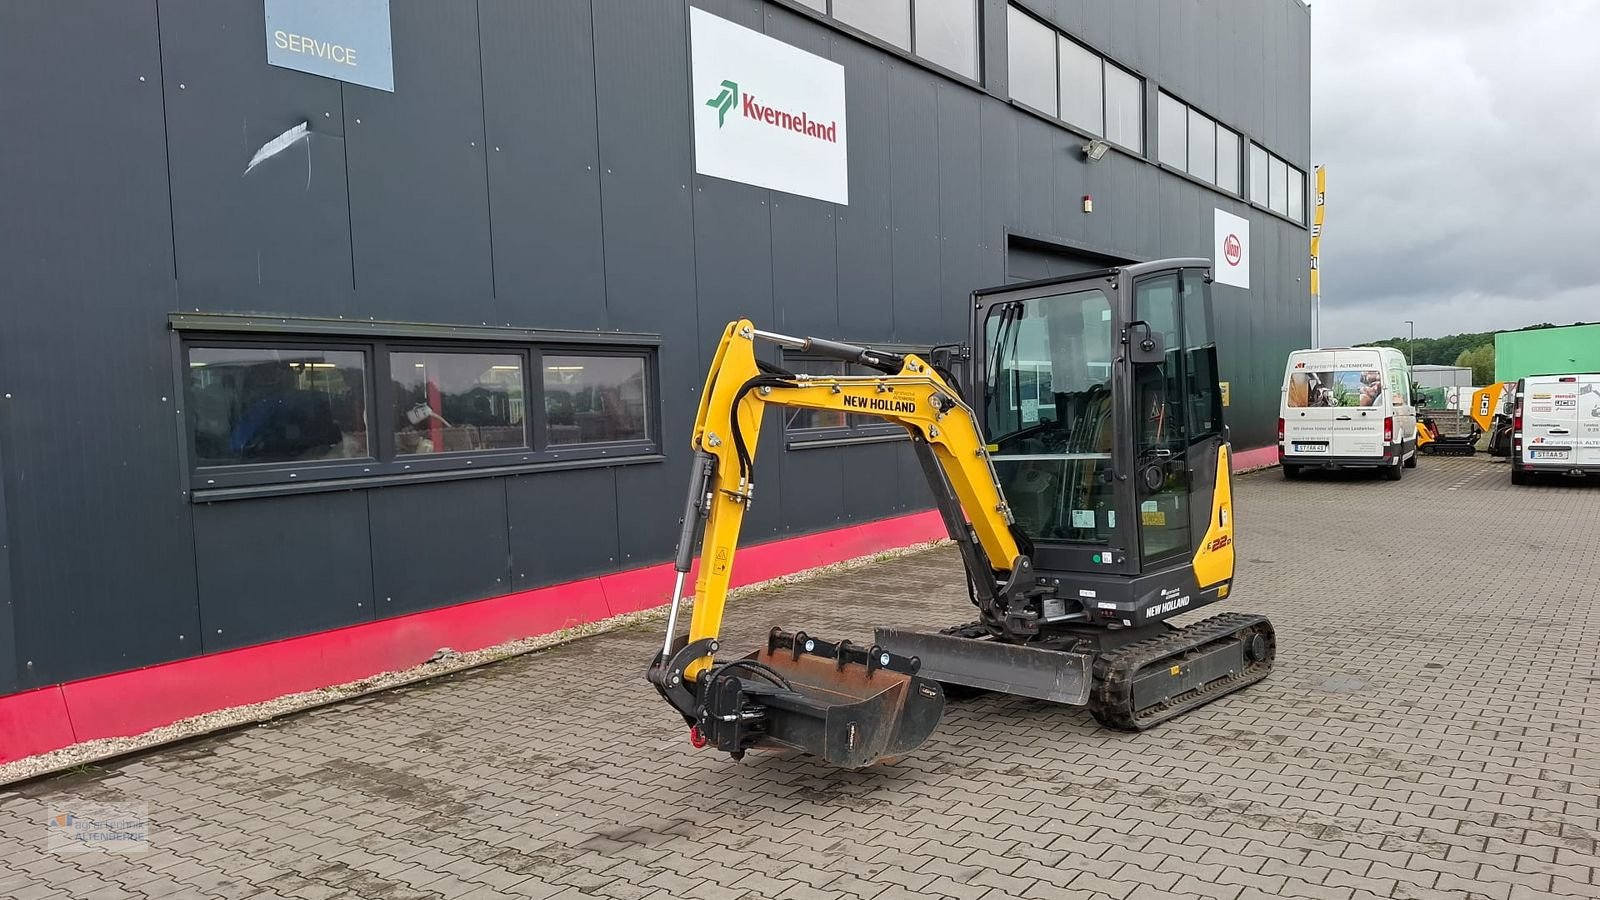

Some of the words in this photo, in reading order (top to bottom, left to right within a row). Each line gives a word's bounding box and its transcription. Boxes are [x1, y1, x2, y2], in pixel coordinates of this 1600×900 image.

[274, 30, 357, 66] SERVICE
[743, 92, 837, 143] Kverneland
[843, 395, 868, 408] NEW
[870, 398, 916, 413] HOLLAND
[1481, 393, 1489, 416] JCB
[1146, 604, 1161, 618] NEW
[1162, 596, 1190, 613] HOLLAND
